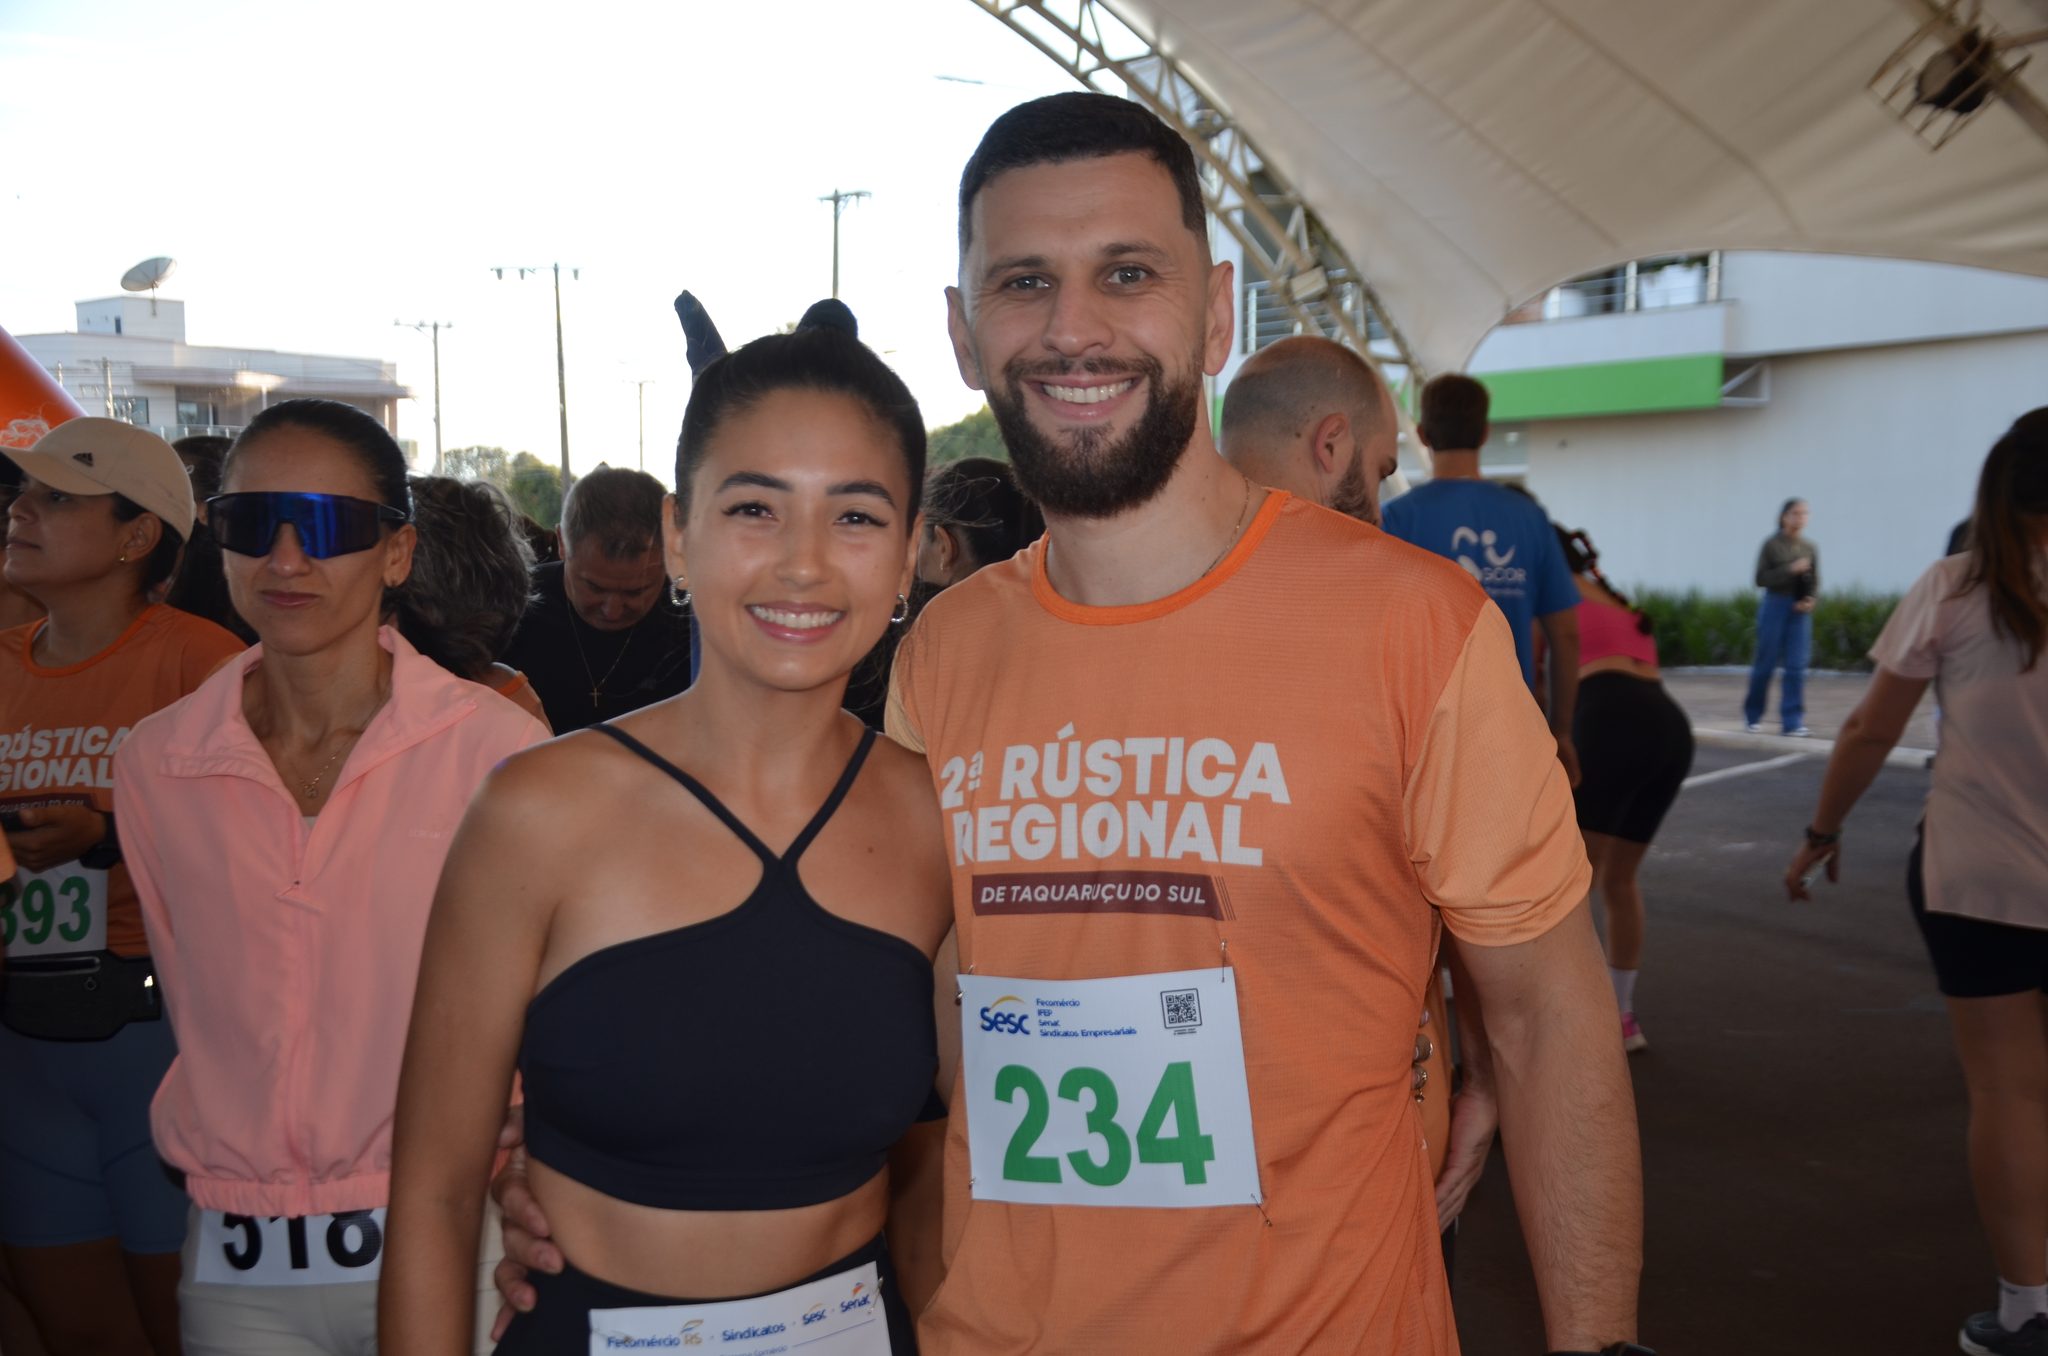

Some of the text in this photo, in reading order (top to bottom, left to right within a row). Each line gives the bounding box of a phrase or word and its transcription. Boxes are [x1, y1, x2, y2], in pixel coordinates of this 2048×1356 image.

[940, 722, 1291, 809] 2ª RÚSTICA
[952, 801, 1263, 867] REGIONAL
[981, 883, 1206, 904] DE TAQUARUÇU DO SUL
[1036, 998, 1080, 1008] Fecomércio
[980, 1006, 1031, 1036] Sesc
[1040, 1026, 1137, 1037] Sindicatos Empresariais
[994, 1061, 1215, 1186] 234
[722, 1322, 786, 1342] Sindicatos
[802, 1308, 827, 1326] Sesc
